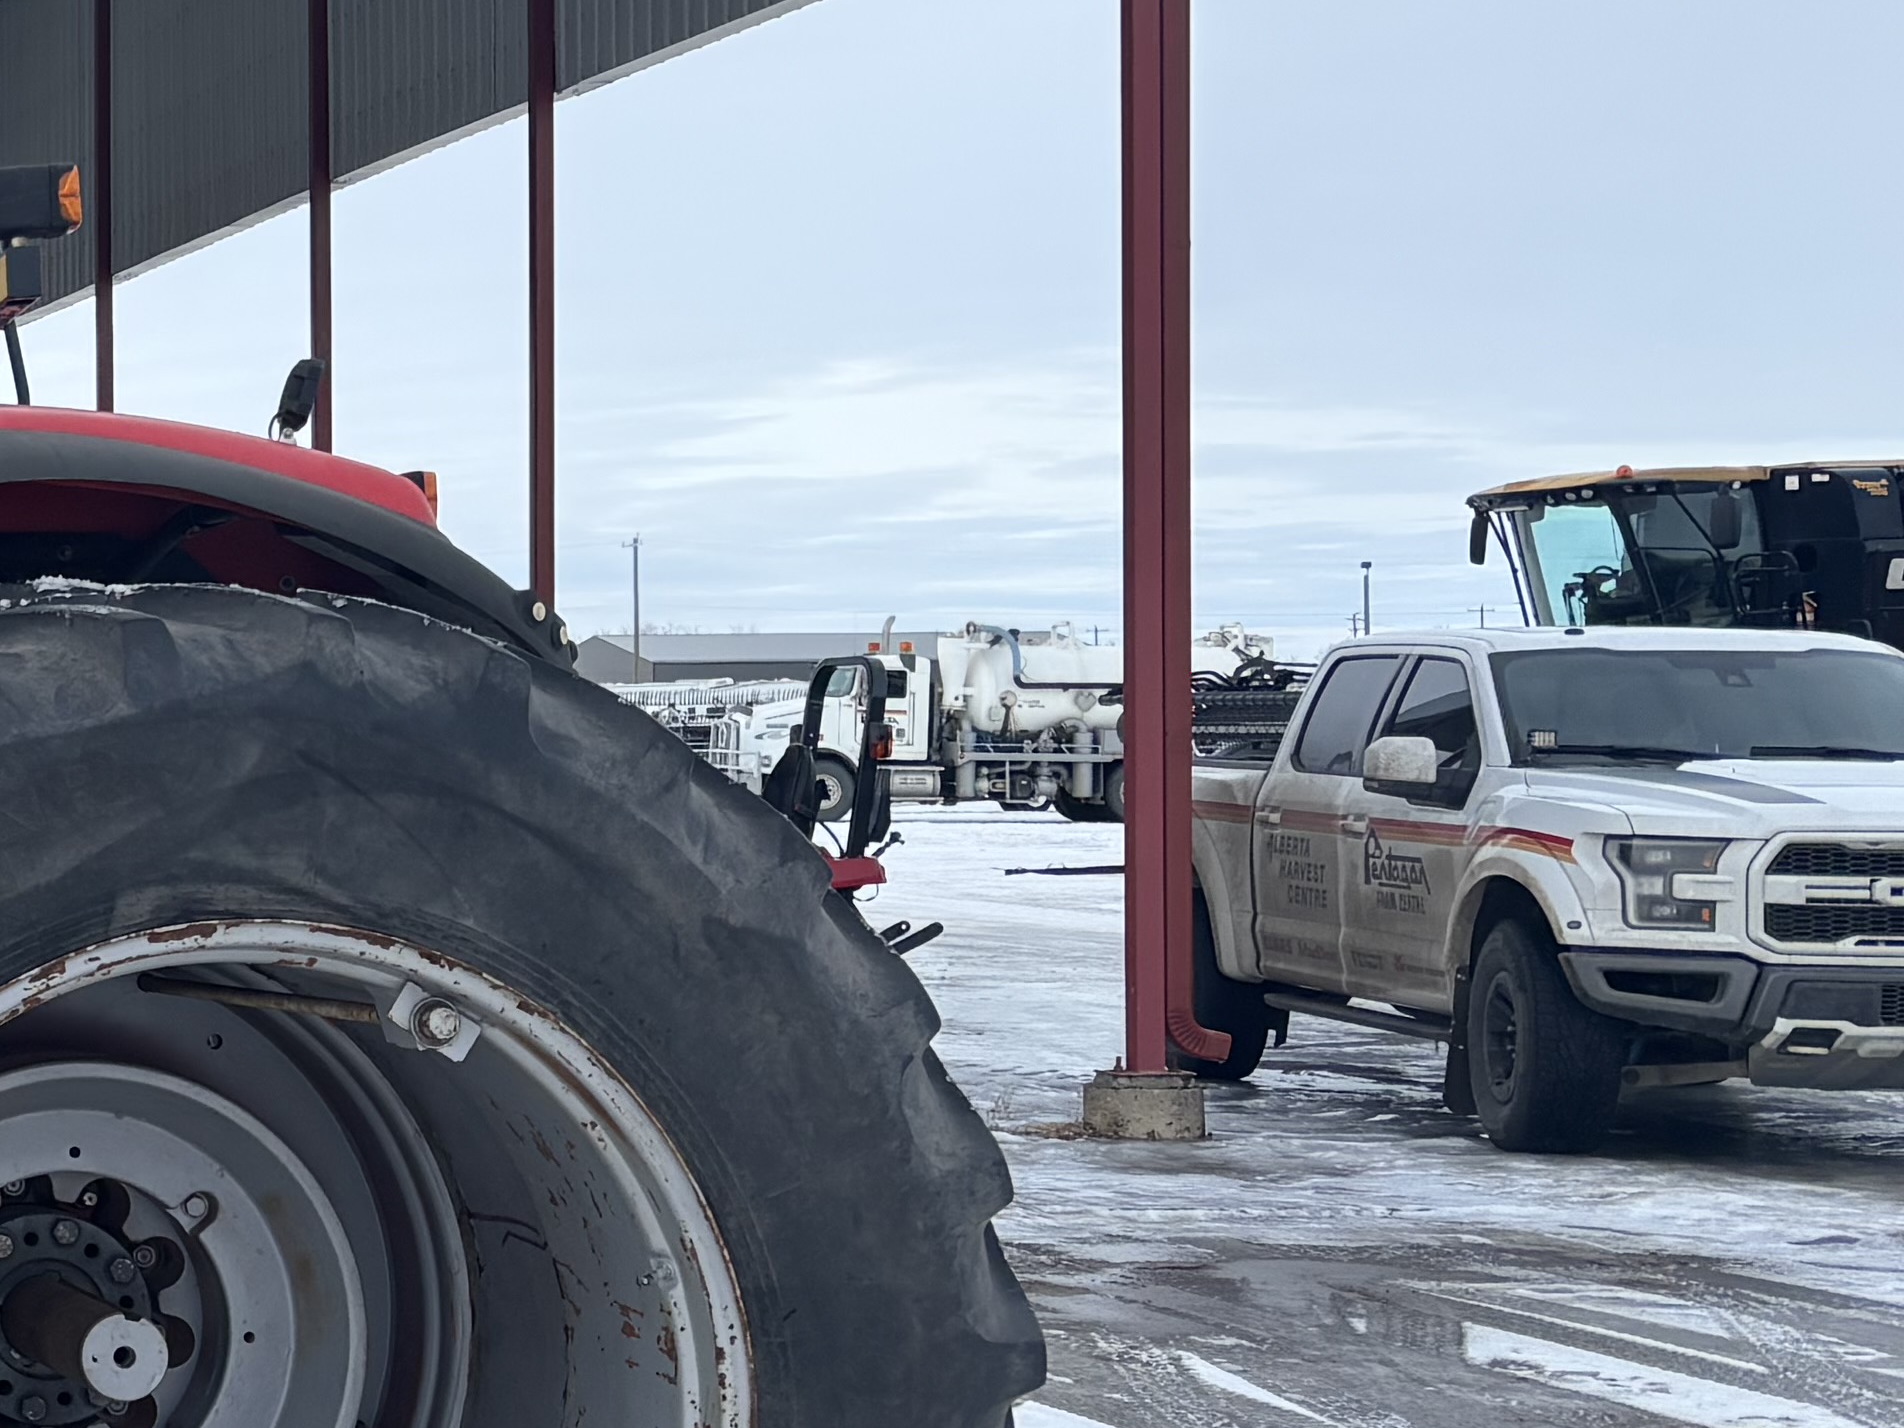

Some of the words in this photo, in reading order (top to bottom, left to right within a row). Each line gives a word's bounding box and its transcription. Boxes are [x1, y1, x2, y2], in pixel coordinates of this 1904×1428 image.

[1267, 833, 1311, 862] ALBERTA
[1279, 863, 1326, 885] HARVEST
[1288, 885, 1328, 909] CENTRE
